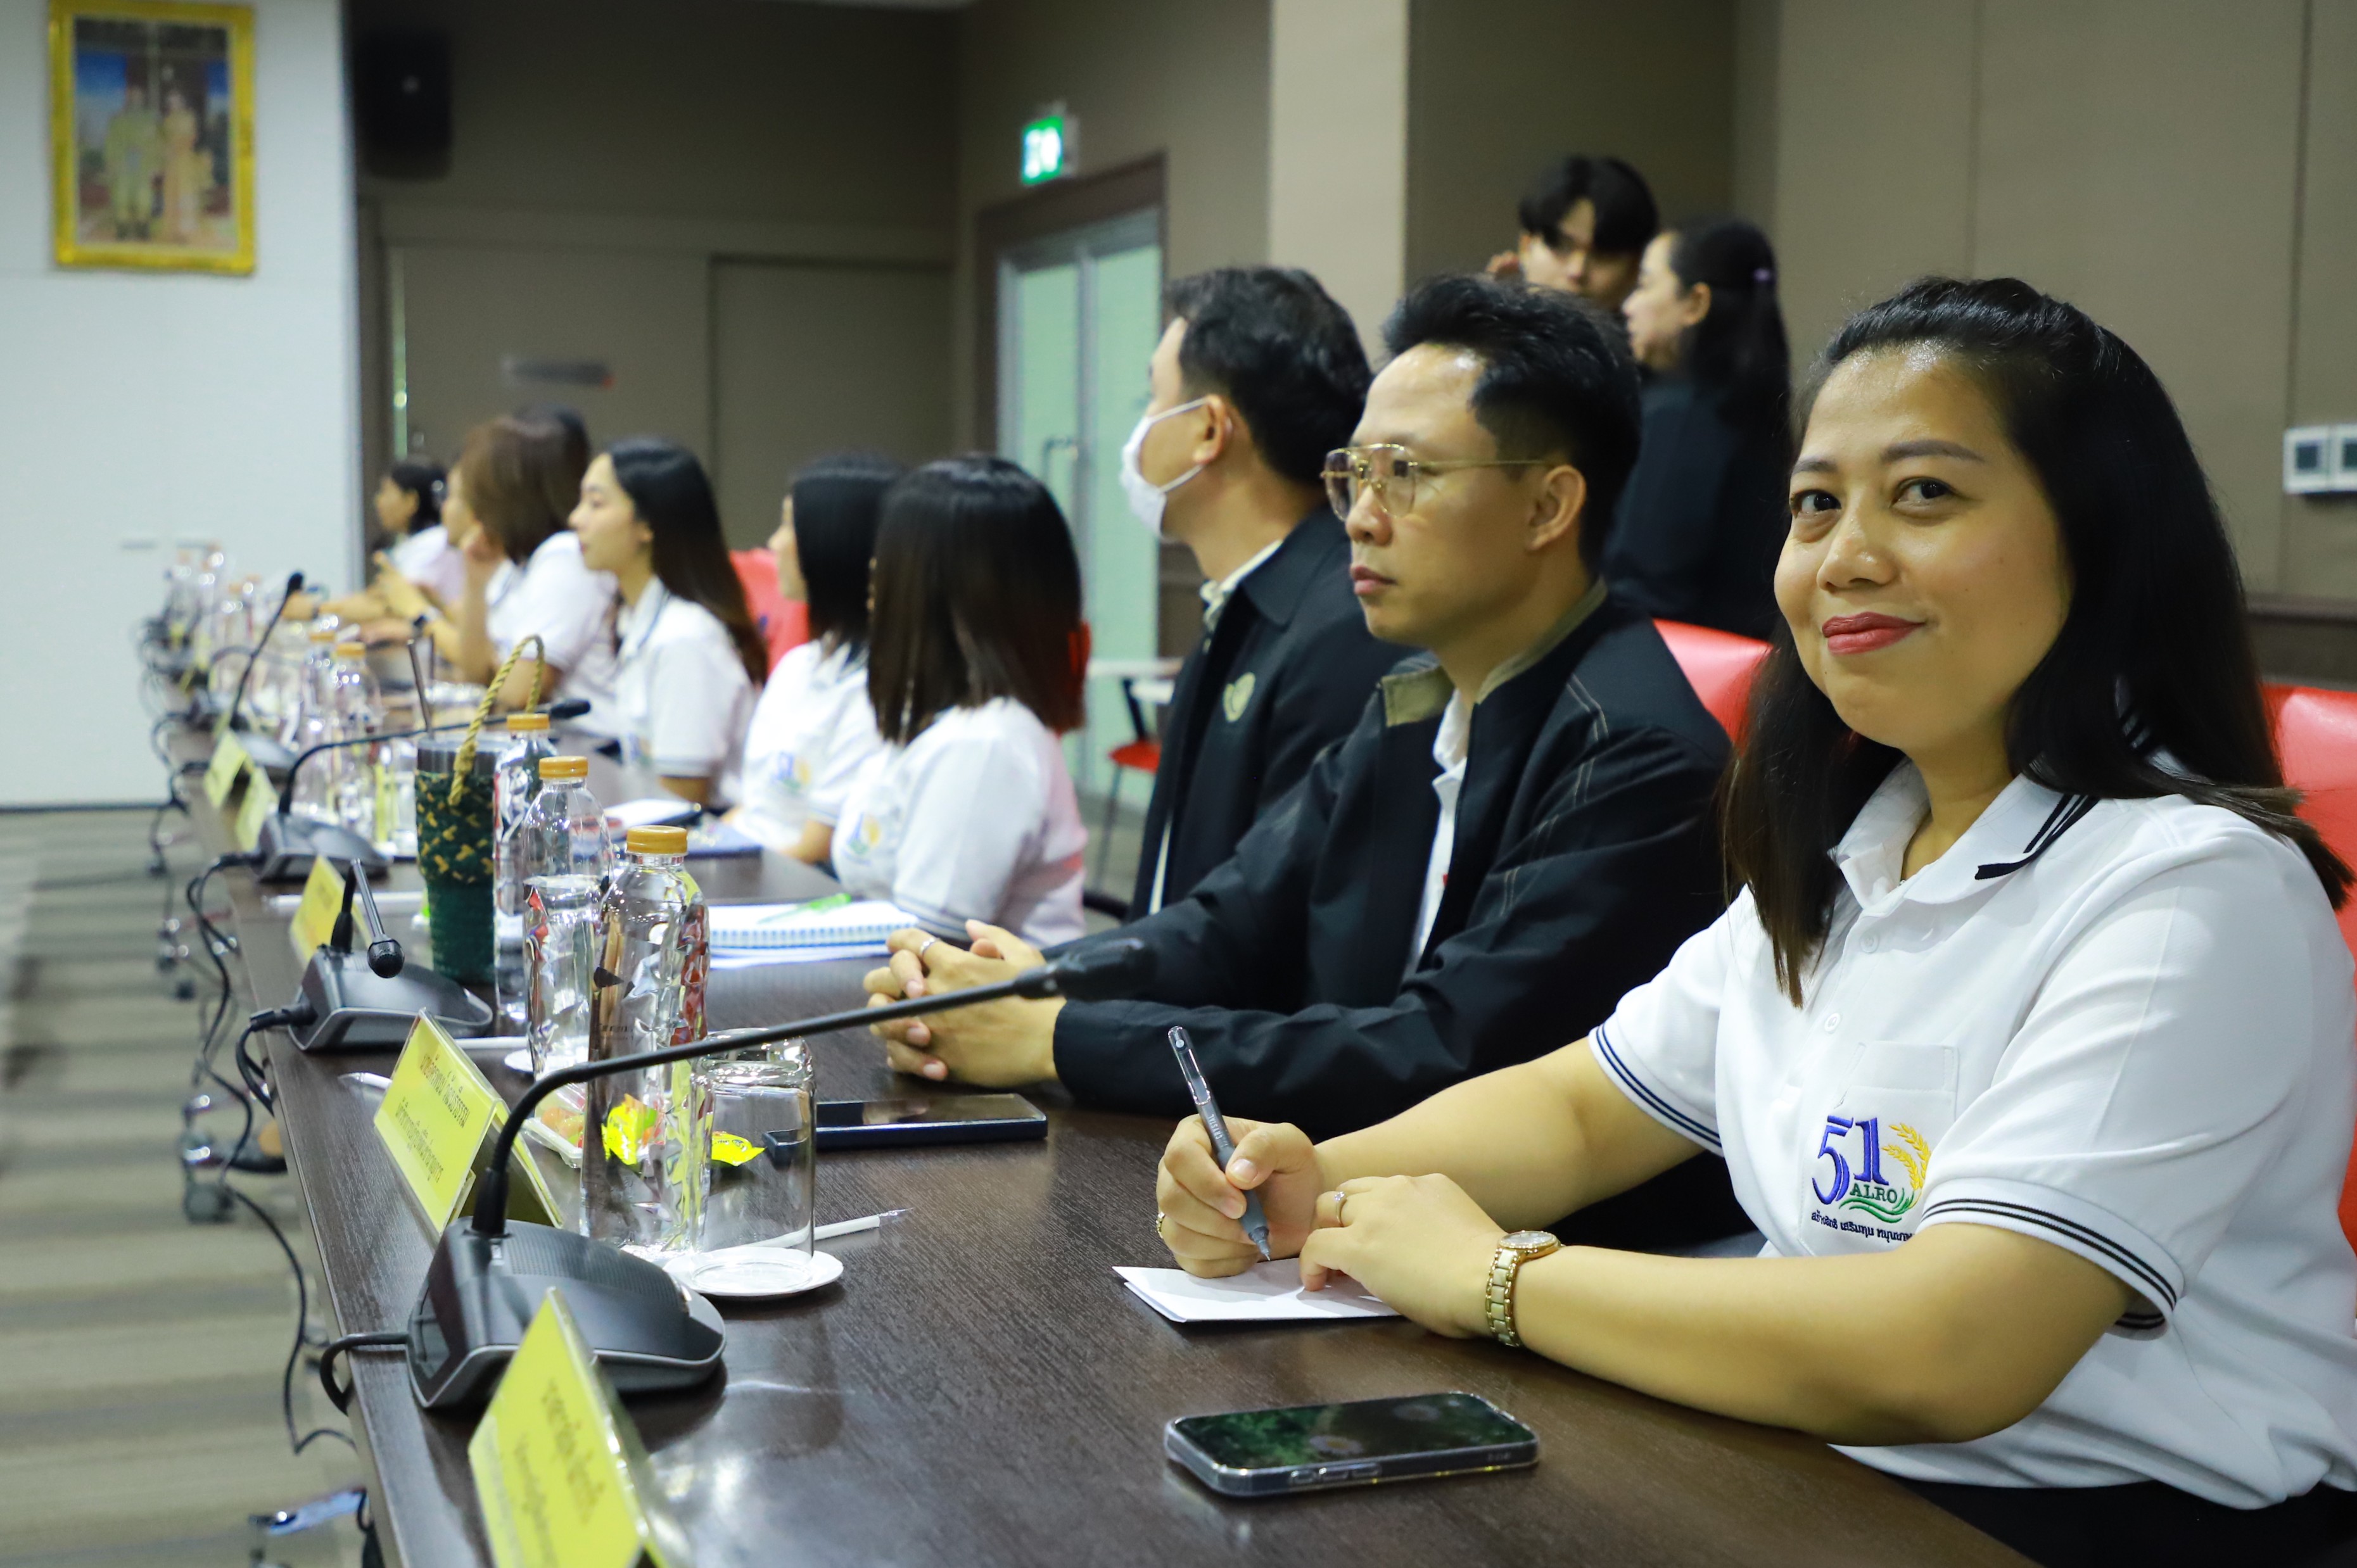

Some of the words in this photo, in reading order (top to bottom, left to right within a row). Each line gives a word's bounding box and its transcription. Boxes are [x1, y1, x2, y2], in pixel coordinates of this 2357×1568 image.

[1207, 1113, 1223, 1140] CRYSTAL
[1812, 1115, 1890, 1205] 51
[1849, 1182, 1898, 1204] ALRO
